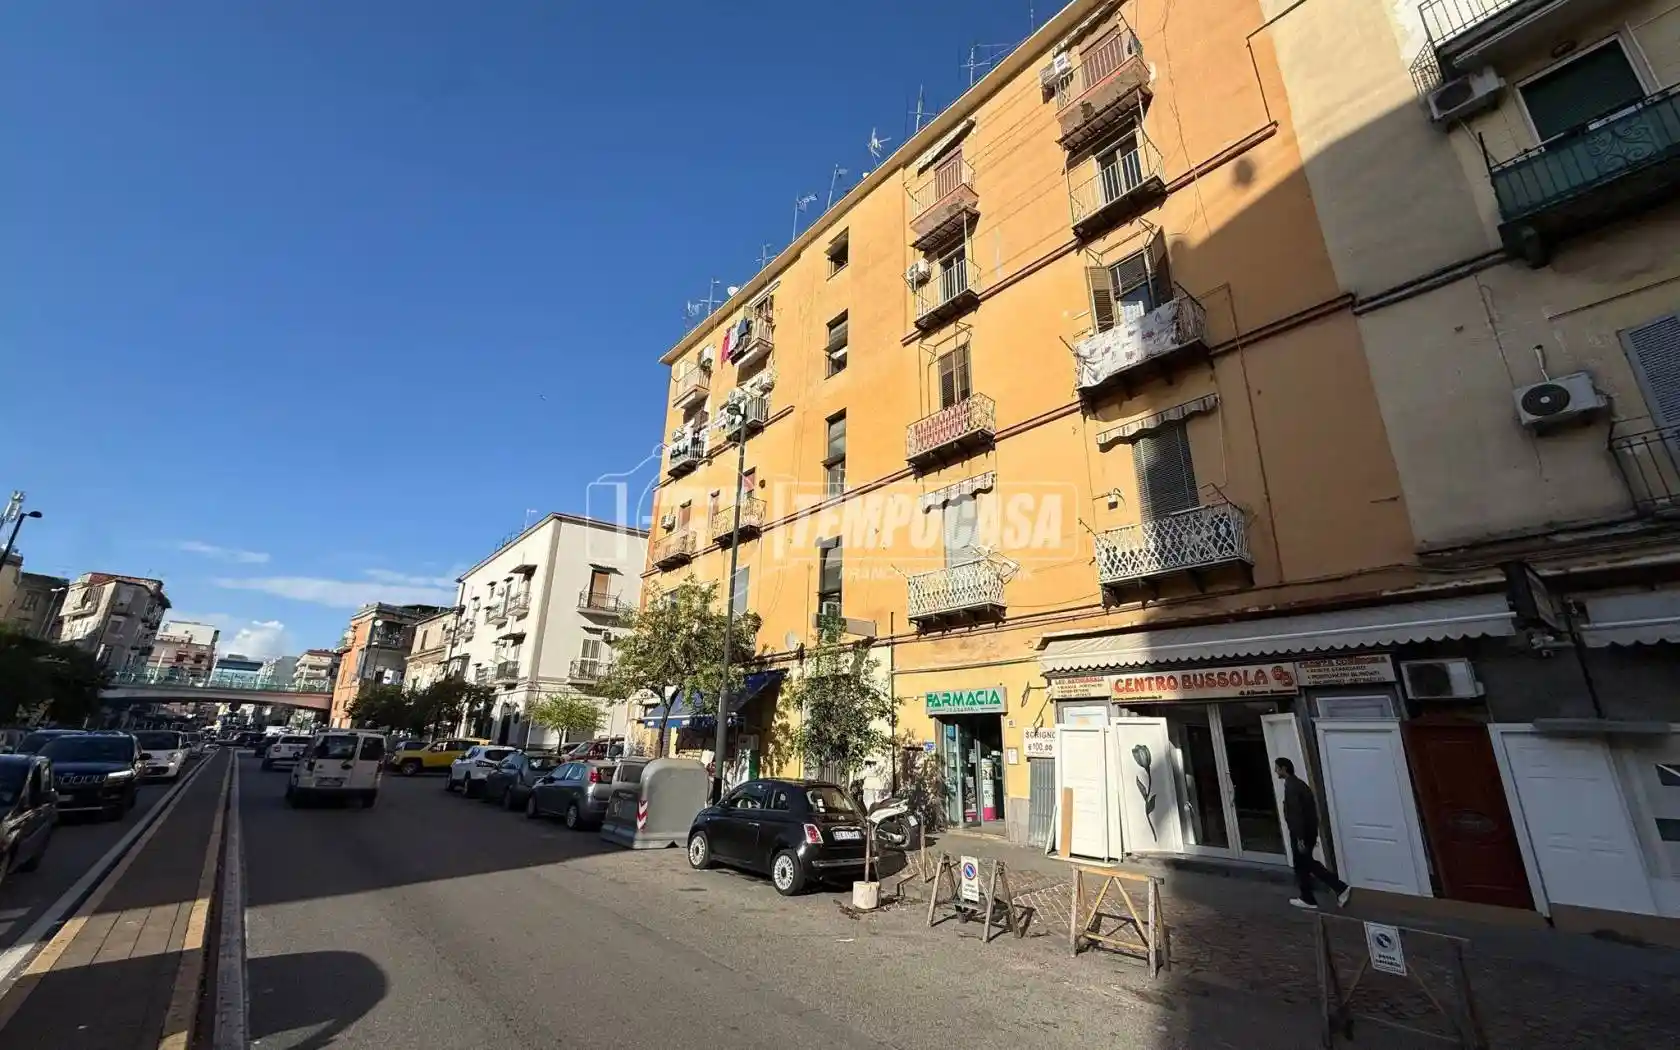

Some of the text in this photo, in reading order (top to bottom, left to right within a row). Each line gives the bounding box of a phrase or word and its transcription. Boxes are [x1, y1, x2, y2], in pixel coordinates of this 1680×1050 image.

[1114, 674, 1179, 693] CENTRO
[1181, 669, 1269, 690] BUSSOLA
[926, 689, 1001, 708] FARMACIA
